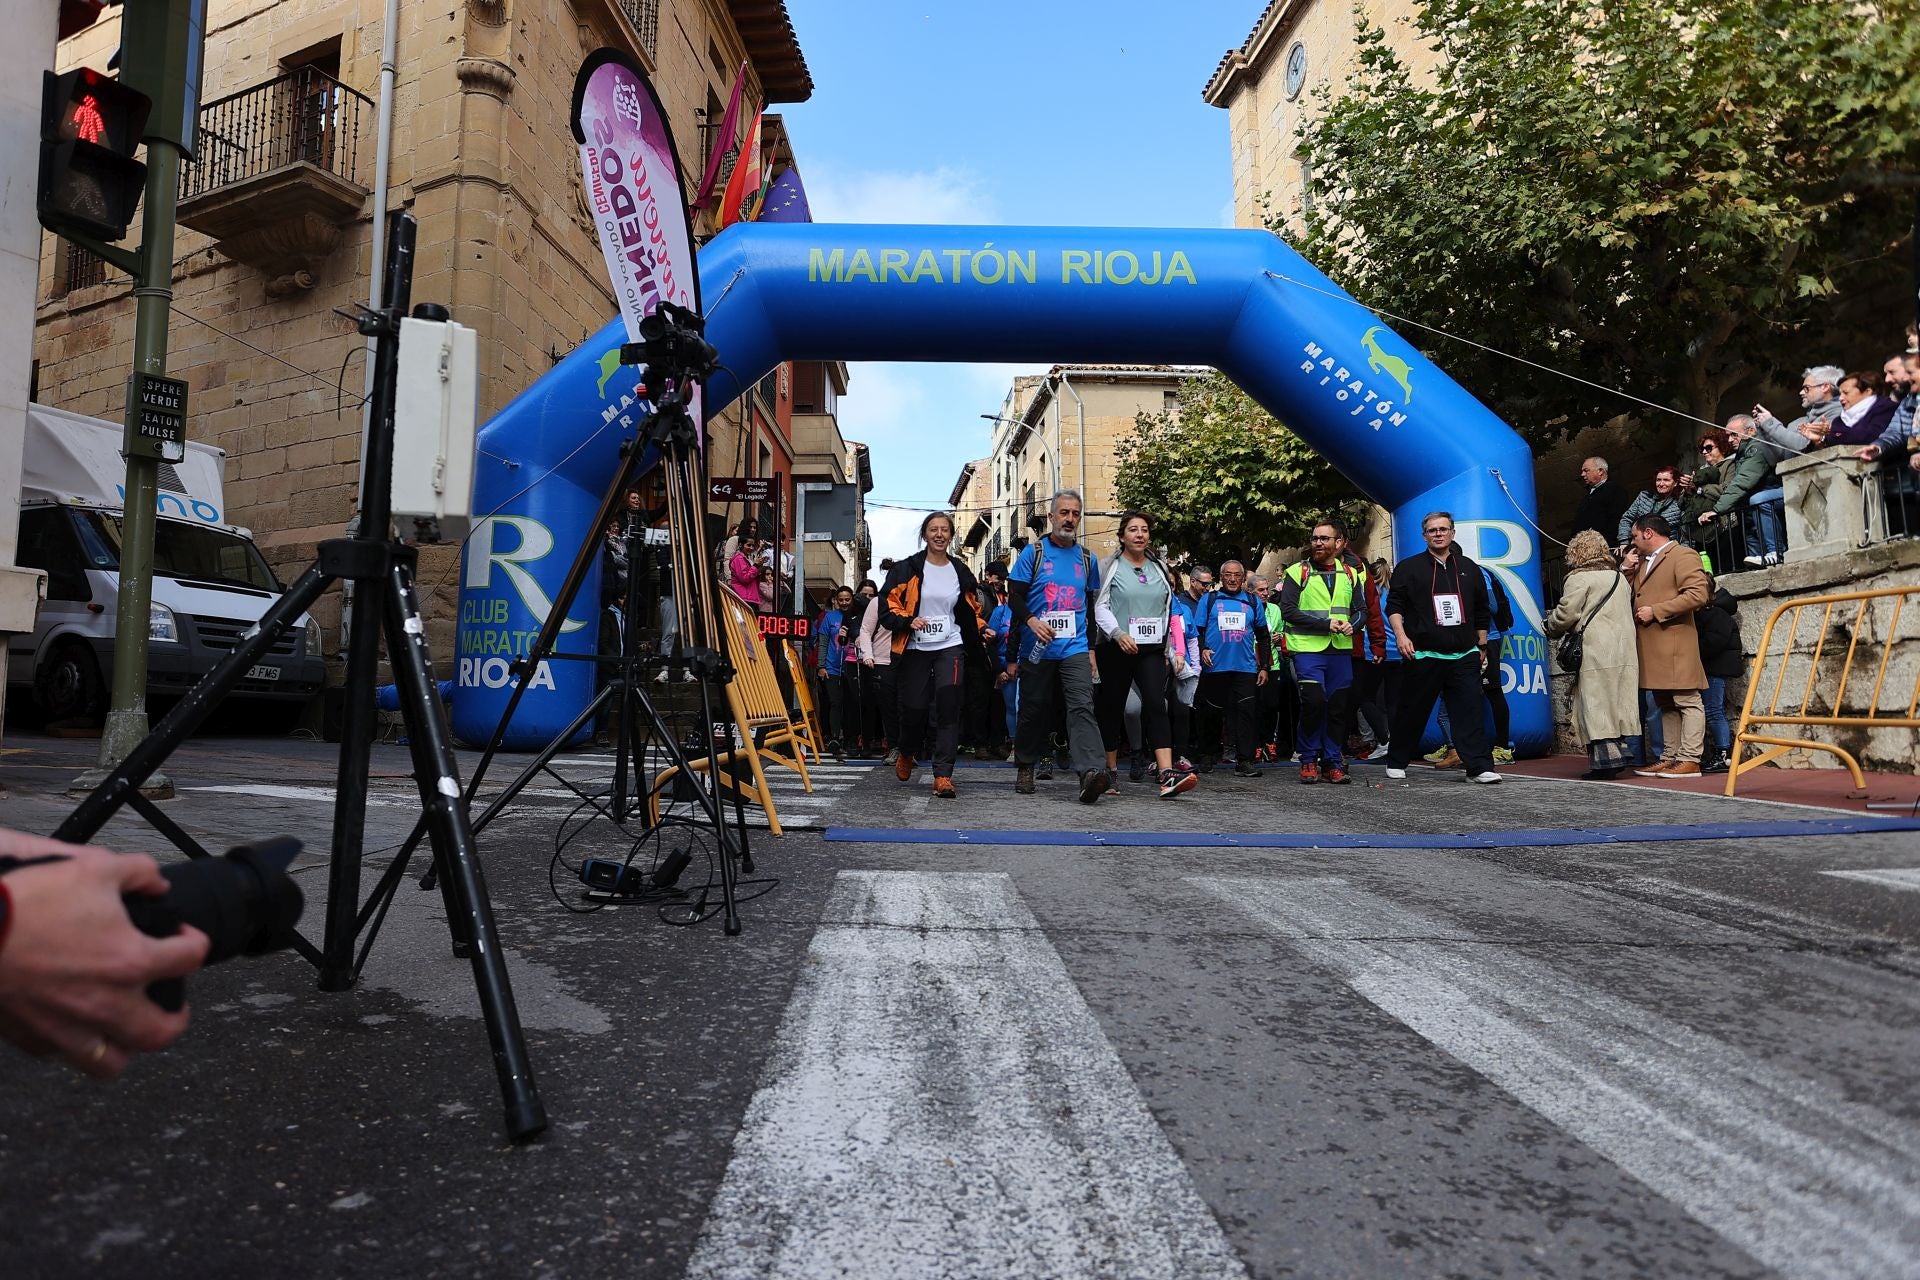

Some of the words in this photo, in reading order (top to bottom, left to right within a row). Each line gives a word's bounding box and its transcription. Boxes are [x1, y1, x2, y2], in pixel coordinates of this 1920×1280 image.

[808, 242, 1036, 284] MARATÓN
[1061, 250, 1198, 284] RIOJA
[143, 381, 182, 396] SPERE
[1303, 341, 1408, 427] MARATÓN
[142, 392, 179, 408] VERDE
[1300, 360, 1383, 431] RIOJA
[141, 425, 175, 440] PULSE
[465, 515, 588, 633] R
[463, 599, 509, 624] CLUB
[1442, 601, 1453, 619] 1090
[757, 615, 808, 637] 0:08:18
[1047, 619, 1068, 629] 1091
[1225, 616, 1239, 624] 1141
[1137, 625, 1156, 635] 1061
[259, 667, 278, 678] FMS
[1500, 662, 1548, 695] OJA
